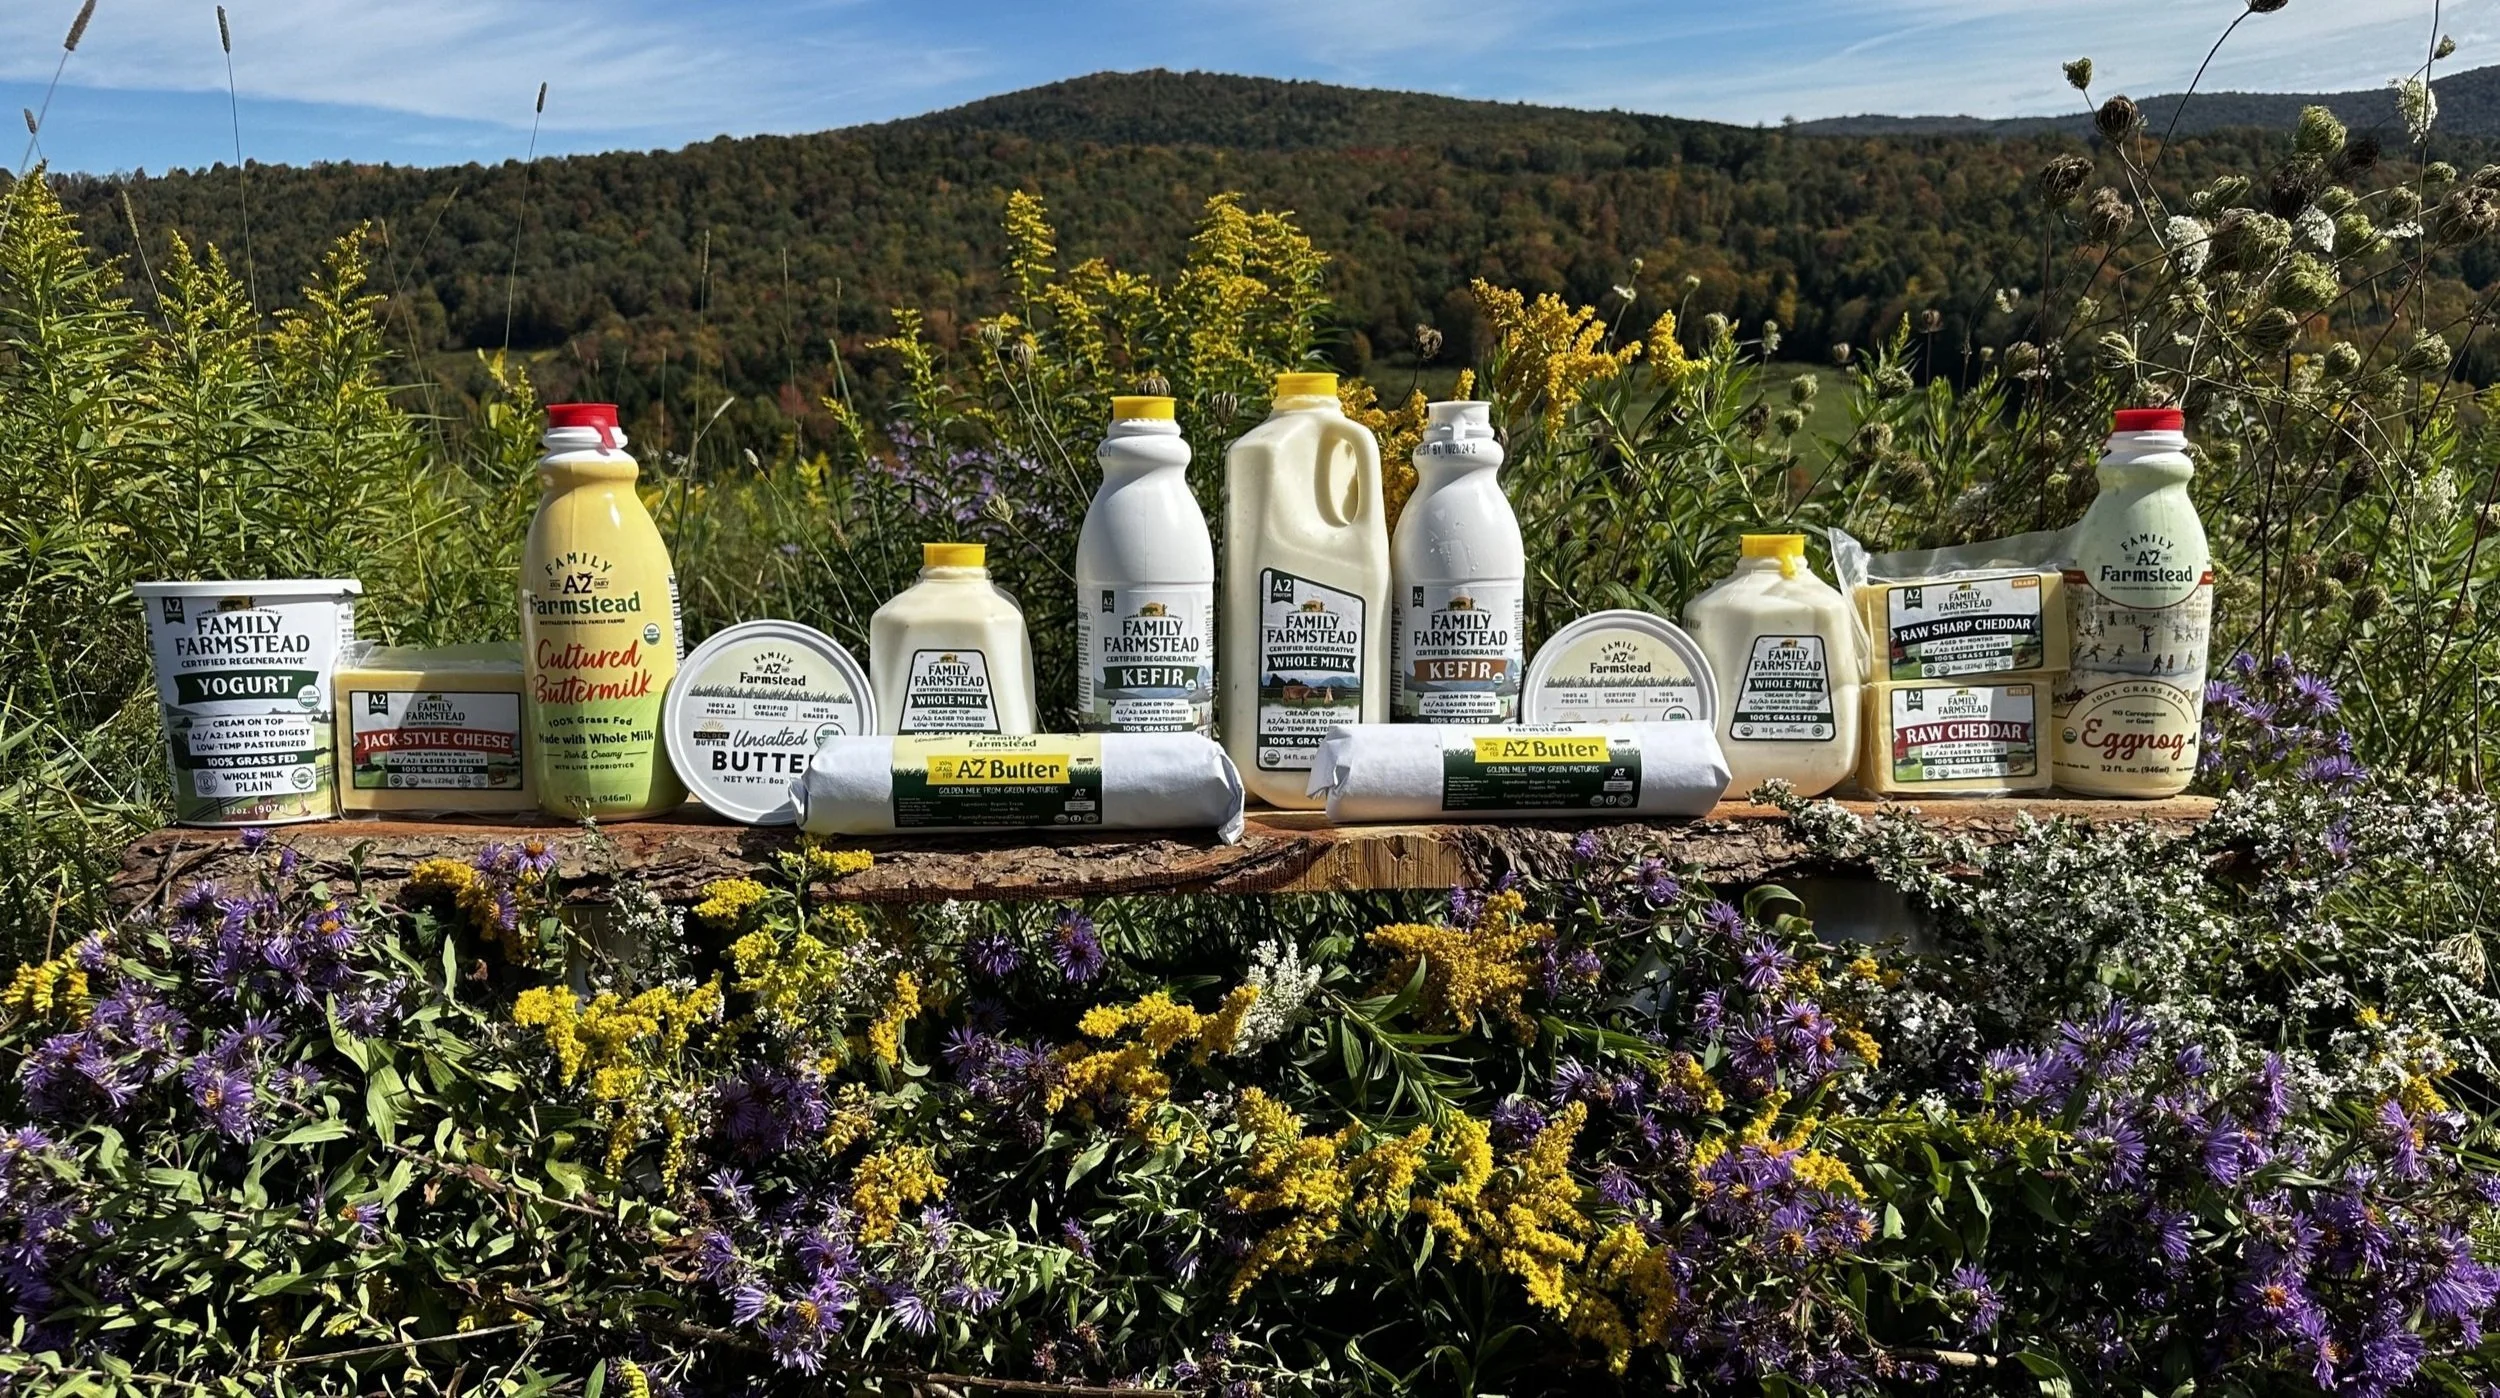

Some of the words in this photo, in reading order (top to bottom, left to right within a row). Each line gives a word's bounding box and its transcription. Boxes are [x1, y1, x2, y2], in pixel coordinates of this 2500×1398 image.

[2120, 534, 2174, 550] FAMILY
[545, 552, 613, 575] FAMILY
[2136, 549, 2160, 566] A2
[2100, 565, 2192, 582] Farmstead
[562, 572, 593, 594] A2
[1274, 580, 1292, 592] A2
[1906, 590, 1920, 599] A2
[1949, 591, 1981, 601] FAMILY
[165, 599, 181, 613] A2
[529, 591, 640, 615] Farmstead
[1104, 597, 1112, 605] A2
[1938, 599, 1992, 611] FARMSTEAD
[197, 615, 282, 635] FAMILY
[1286, 616, 1339, 629] FAMILY
[1431, 614, 1491, 629] FAMILY
[1123, 620, 1183, 636] FAMILY
[1900, 626, 1929, 642] RAW
[1932, 621, 1972, 635] SHARP
[1975, 618, 2031, 631] CHEDDAR
[1267, 630, 1357, 644] FARMSTEAD
[1414, 631, 1508, 646] FARMSTEAD
[175, 635, 310, 655] FARMSTEAD
[1104, 637, 1199, 652] FARMSTEAD
[1601, 641, 1639, 653] FAMILY
[537, 638, 641, 668] Cultured
[753, 652, 794, 664] FAMILY
[1612, 651, 1628, 662] A2
[1768, 650, 1809, 660] FAMILY
[181, 658, 226, 668] CERTIFIED
[763, 663, 781, 674] A2
[1273, 657, 1318, 667] WHOLE
[1321, 657, 1350, 668] MILK
[1590, 662, 1651, 674] Farmstead
[1754, 661, 1821, 671] FARMSTEAD
[928, 665, 970, 675] FAMILY
[1429, 661, 1491, 679] KEFIR
[740, 672, 806, 685] Farmstead
[915, 676, 984, 687] FARMSTEAD
[1122, 668, 1184, 686] KEFIR
[197, 676, 292, 695] YOGURT
[533, 668, 652, 705] Buttermilk
[1754, 680, 1792, 688] WHOLE
[1794, 681, 1818, 689] MILK
[371, 694, 386, 705] A2
[916, 696, 955, 704] WHOLE
[957, 697, 983, 705] MILK
[1908, 691, 1921, 700] A2
[1948, 696, 1977, 705] FAMILY
[417, 703, 453, 712] FAMILY
[1938, 705, 1988, 715] FARMSTEAD
[406, 712, 465, 721] FARMSTEAD
[549, 717, 573, 726] 100%
[578, 716, 608, 725] Grass
[613, 717, 632, 725] Fed
[213, 719, 245, 728] CREAM
[192, 730, 223, 741] A2/A2:
[226, 729, 260, 738] EASIER
[263, 729, 276, 737] TO
[539, 733, 560, 744] Made
[562, 733, 585, 744] with
[590, 731, 627, 743] Whole
[631, 730, 653, 741] Milk
[733, 726, 808, 747] Unsalted
[1906, 726, 1942, 744] RAW
[1948, 723, 2021, 739] CHEDDAR
[2081, 718, 2185, 761] Eggnog
[196, 742, 241, 751] LOW-TEMP
[244, 739, 306, 748] PASTEURIZED
[363, 733, 449, 750] JACK-STYLE
[453, 735, 510, 749] CHEESE
[1269, 737, 1293, 745] 100%
[1297, 737, 1323, 745] GRAS
[1503, 740, 1529, 757] A2
[1534, 741, 1598, 757] Butter
[207, 757, 234, 767] 100%
[237, 755, 276, 766] GRASS
[278, 754, 298, 763] FED
[591, 750, 622, 760] Creamy
[712, 751, 813, 774] BUTTE
[956, 757, 986, 778] A2
[990, 760, 1059, 779] Butter
[223, 772, 257, 781] WHOLE
[260, 771, 283, 779] MILK
[1614, 768, 1625, 776] A2
[2141, 766, 2169, 774] (946ml)
[235, 780, 272, 792] PLAIN
[966, 786, 982, 794] MILK
[984, 786, 1001, 794] FROM
[1004, 786, 1024, 794] GREEN
[599, 794, 632, 803] (946ml)
